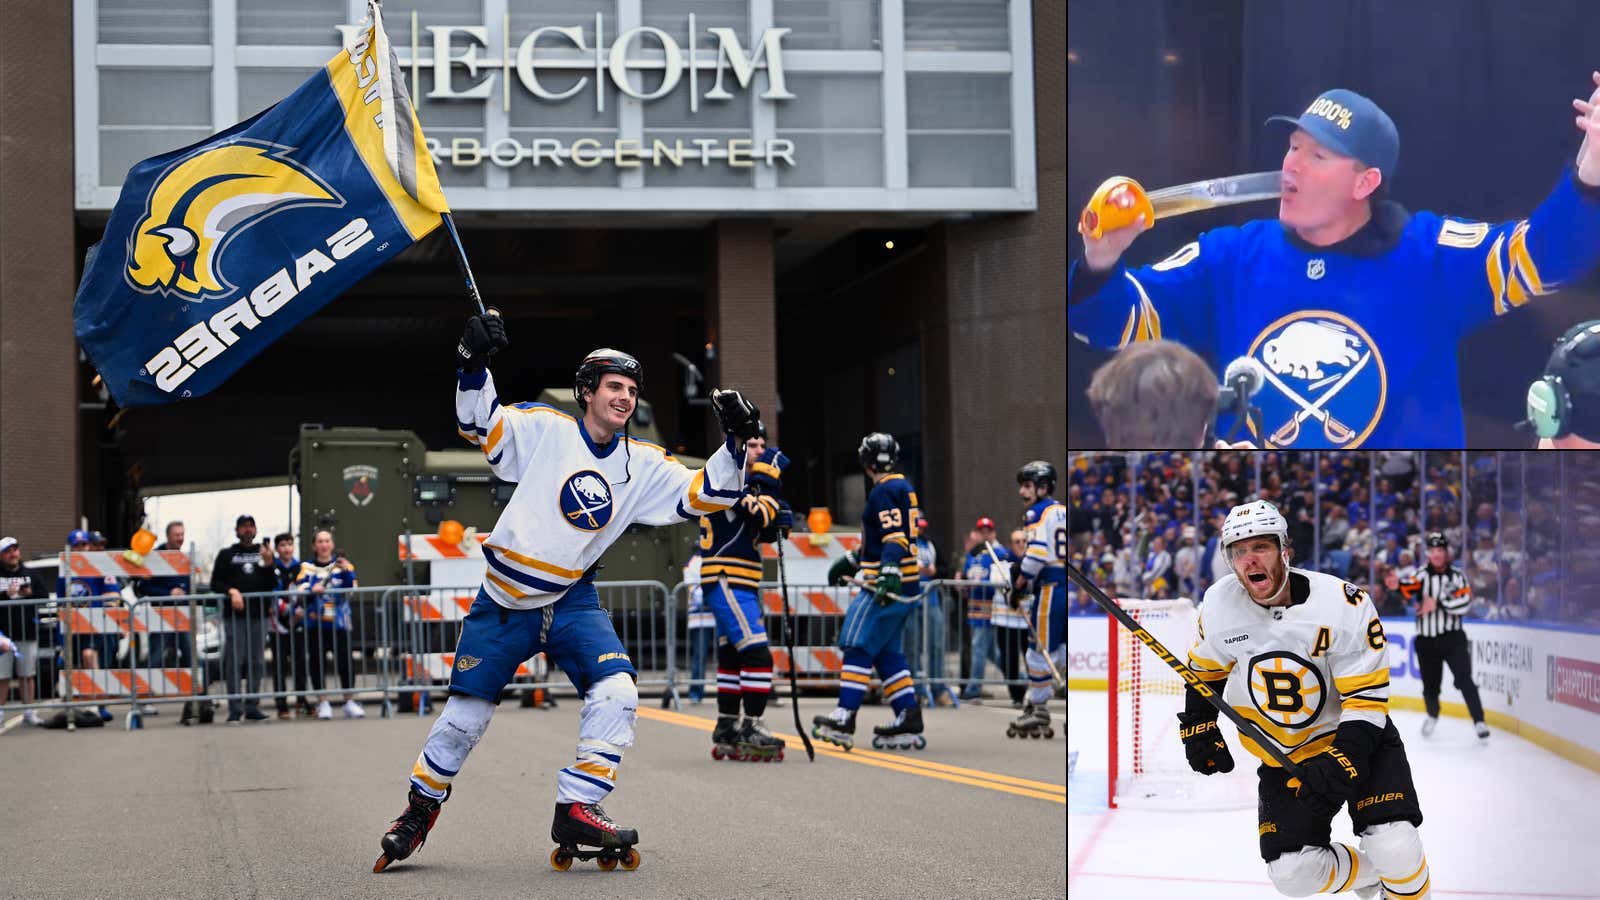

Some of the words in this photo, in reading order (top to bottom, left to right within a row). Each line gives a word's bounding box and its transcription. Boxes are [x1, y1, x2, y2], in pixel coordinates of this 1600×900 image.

[425, 137, 797, 167] RBORCENTER
[878, 508, 903, 529] 53
[1311, 625, 1332, 660] A
[1476, 639, 1534, 673] NORWEGIAN
[1261, 670, 1304, 713] B
[1179, 720, 1217, 739] AUER
[1356, 792, 1405, 811] BAUER
